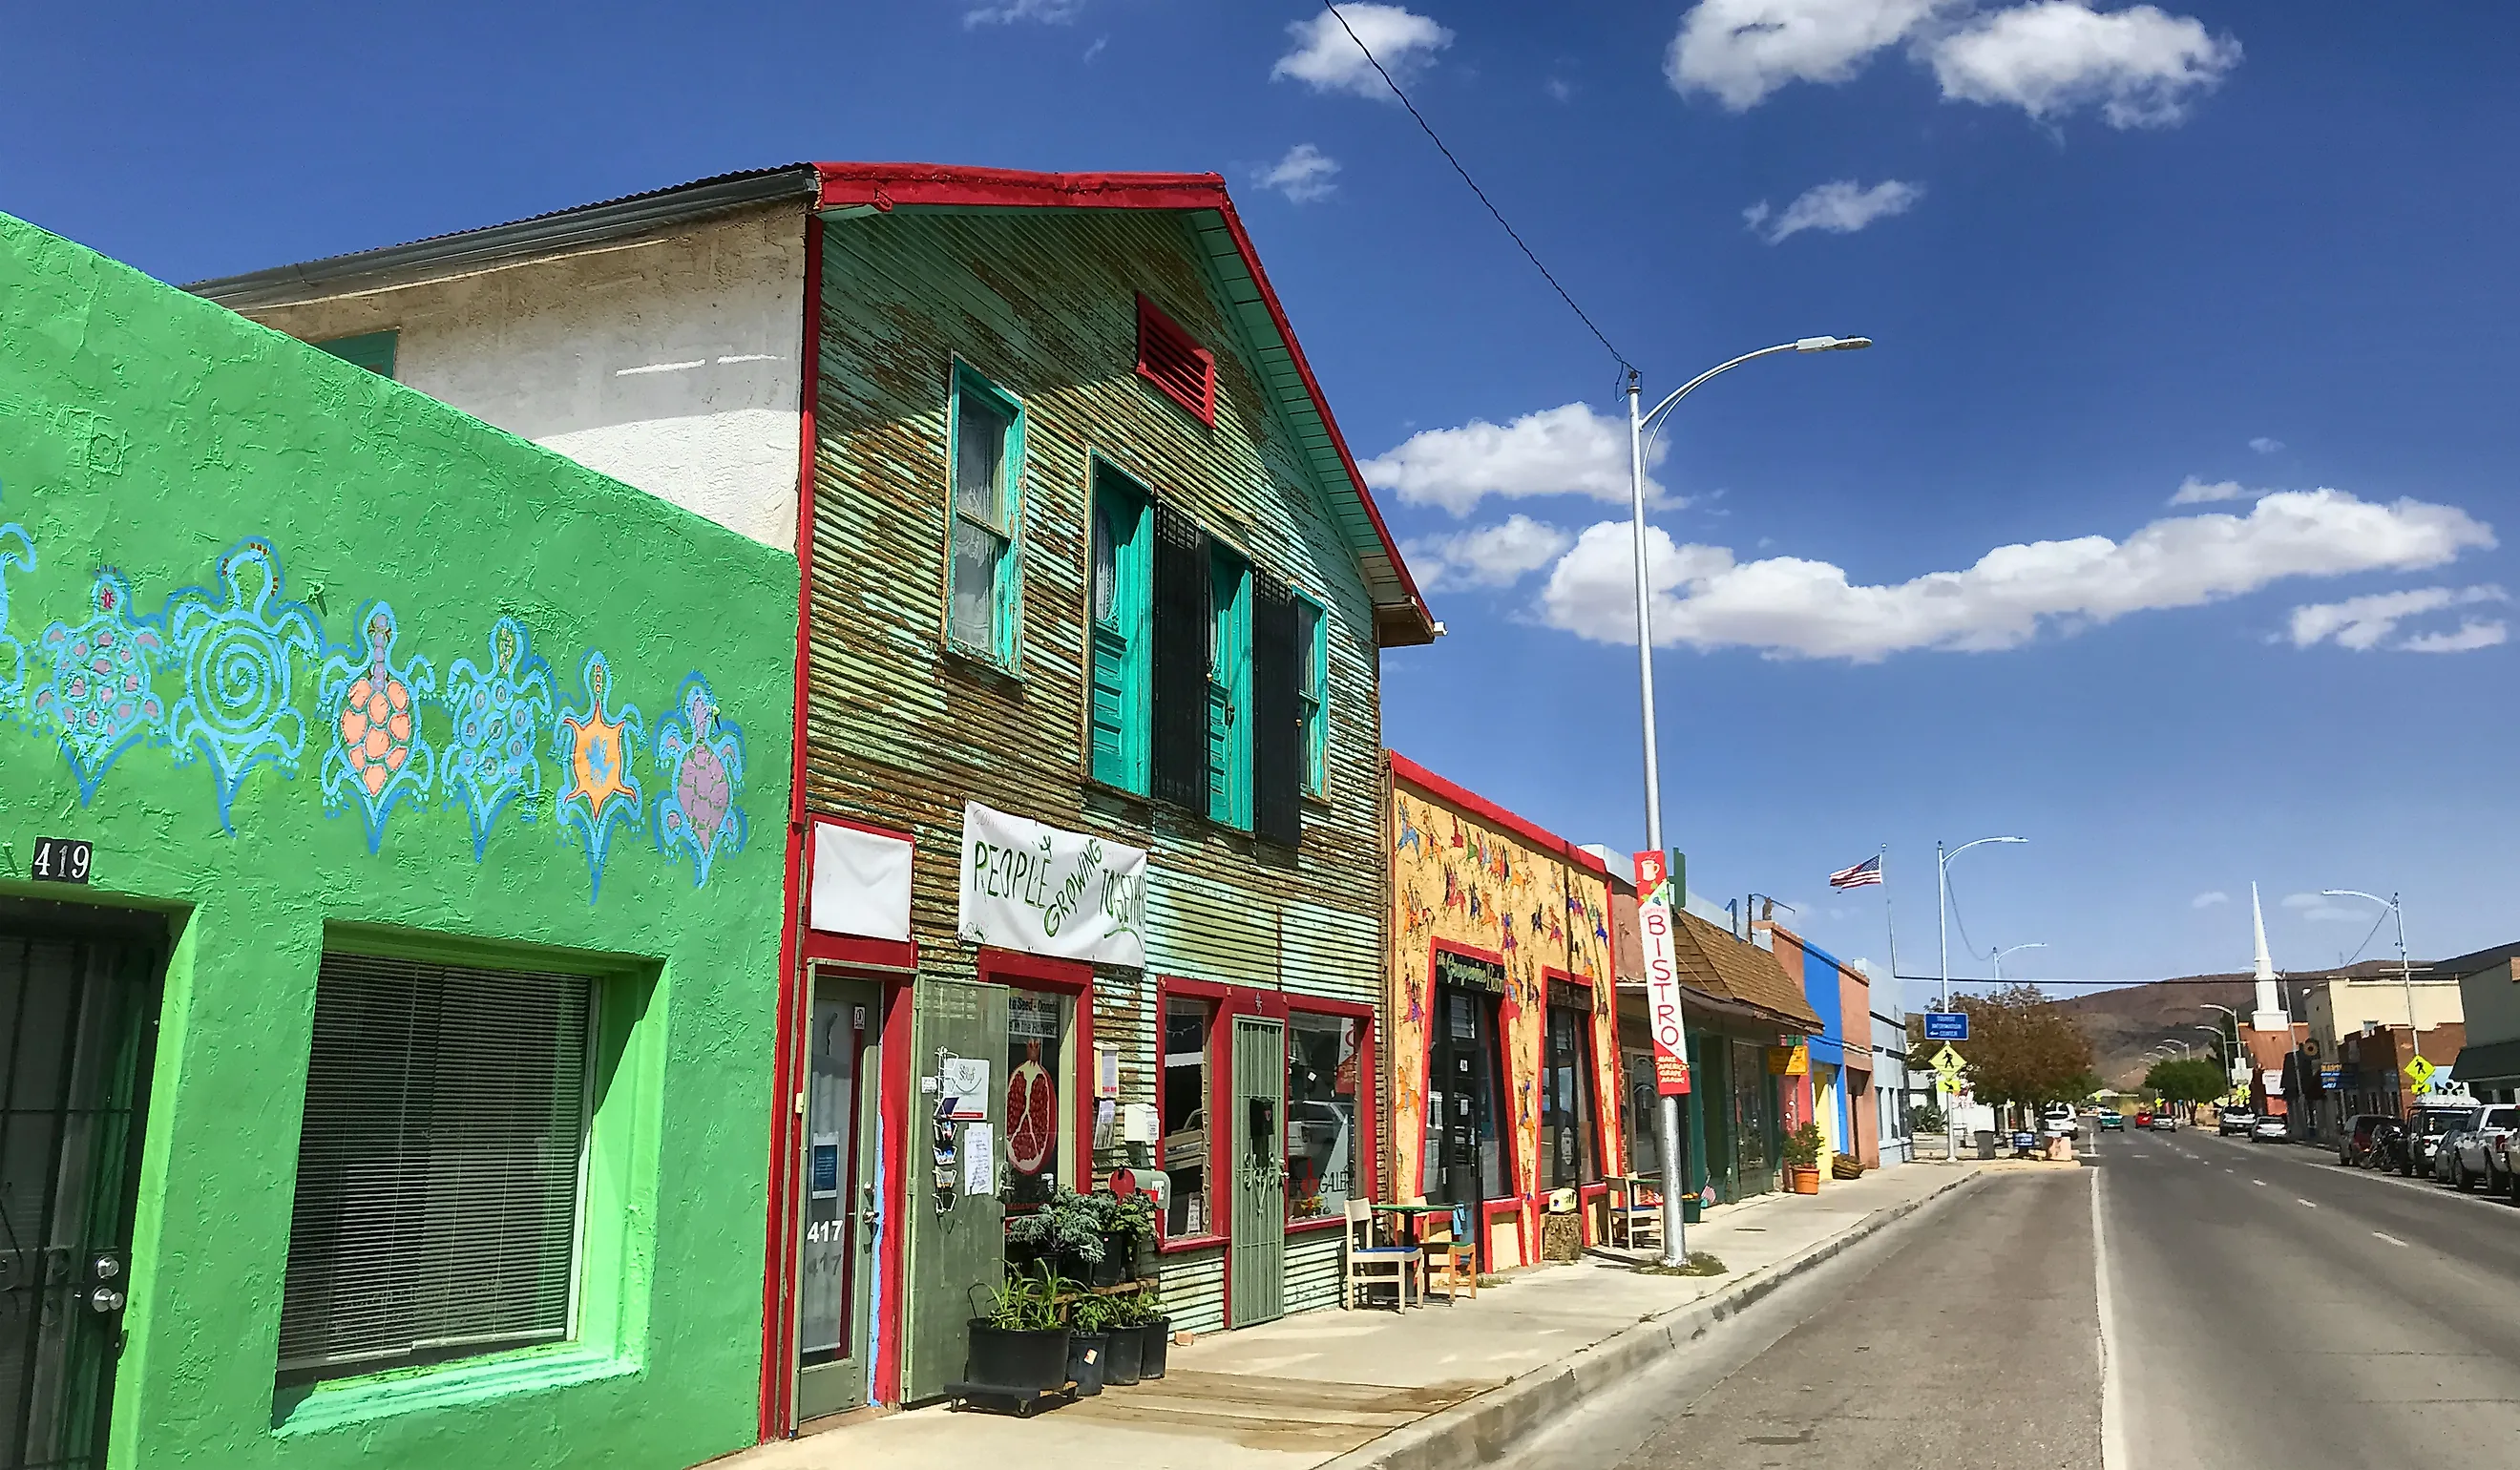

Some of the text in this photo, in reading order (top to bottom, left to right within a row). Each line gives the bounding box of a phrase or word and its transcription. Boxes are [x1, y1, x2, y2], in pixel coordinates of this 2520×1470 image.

[34, 842, 90, 879] 419
[974, 839, 1052, 910] PEOPLE
[1043, 837, 1103, 938] GROWING
[1648, 914, 1680, 1047] BISTRO
[807, 1219, 844, 1244] 417
